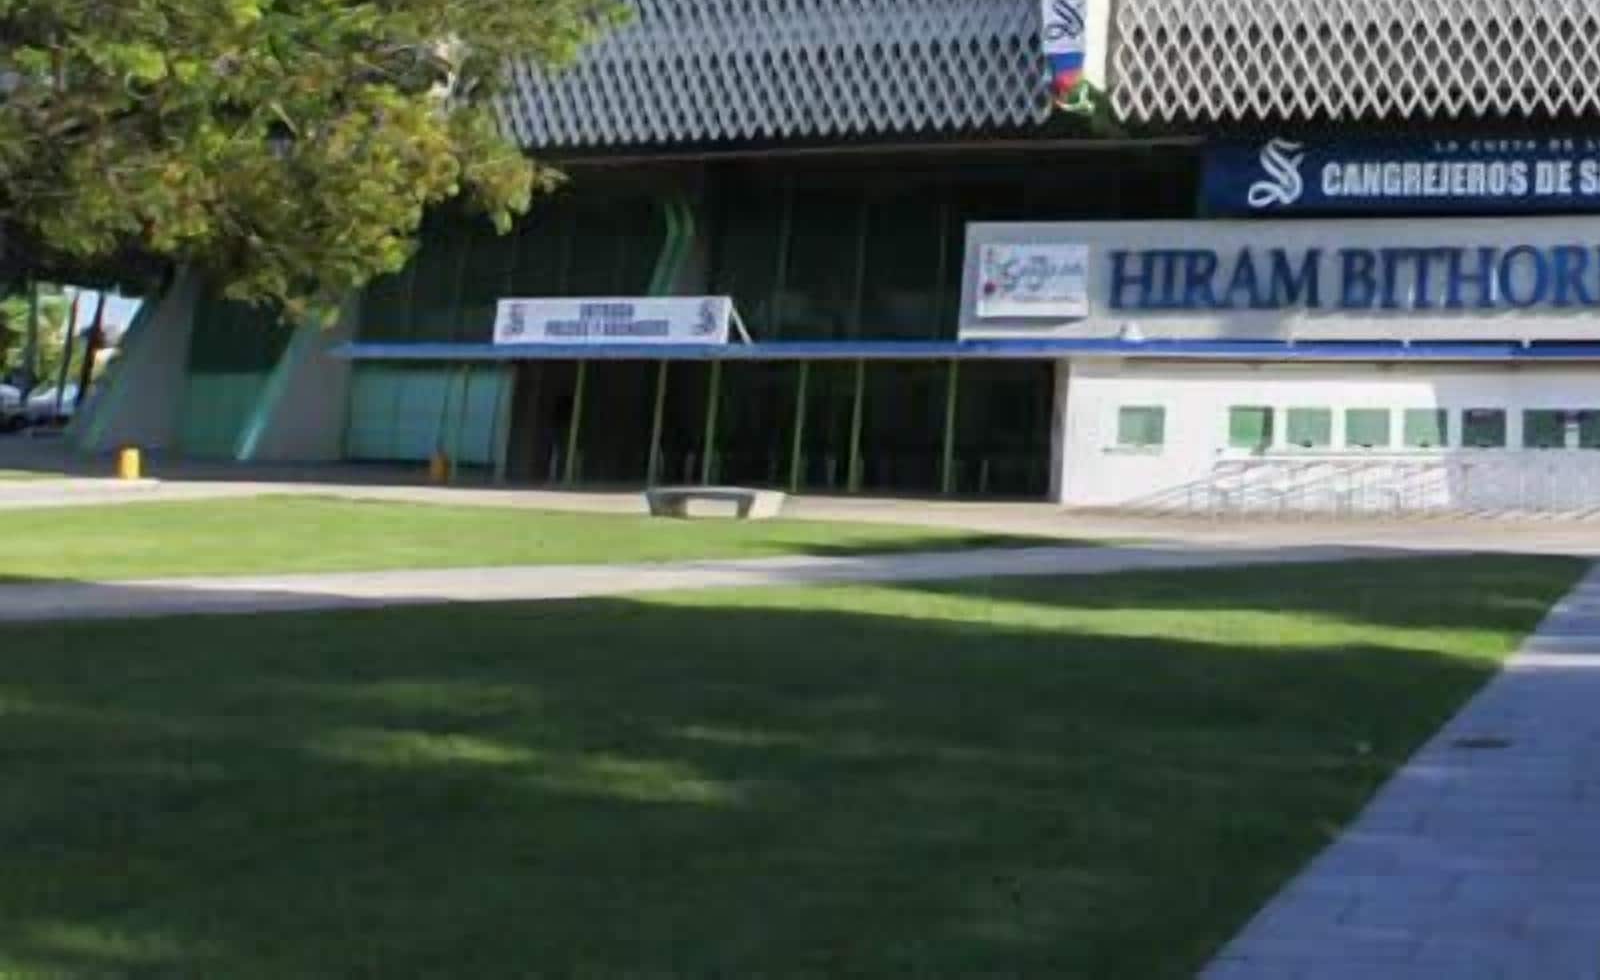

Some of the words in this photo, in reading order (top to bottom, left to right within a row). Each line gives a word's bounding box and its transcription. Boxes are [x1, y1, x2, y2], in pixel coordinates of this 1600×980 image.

[1321, 160, 1529, 196] CANGREJEROS
[1535, 159, 1573, 195] DE
[1108, 245, 1319, 310] HIRAM
